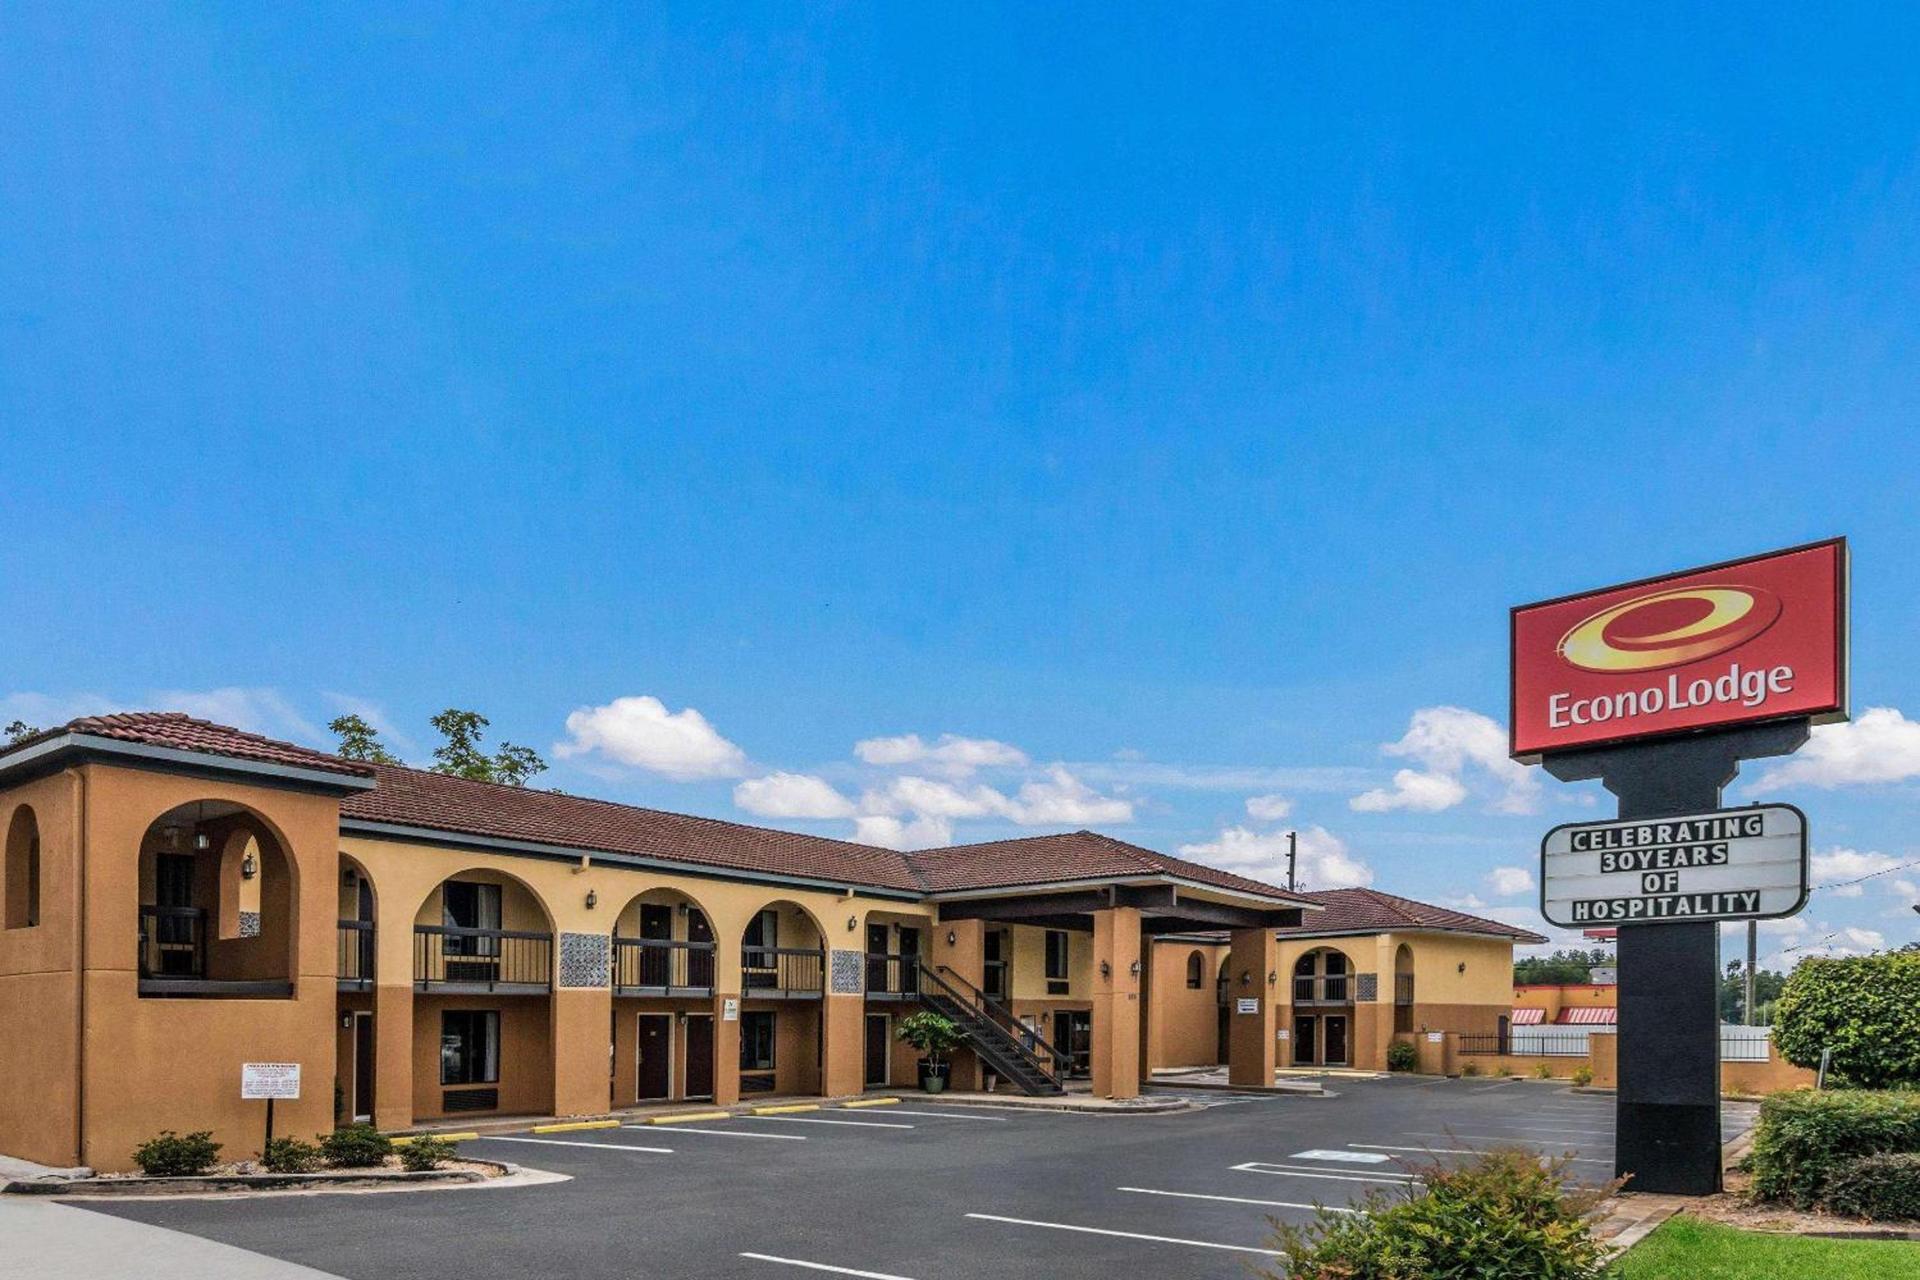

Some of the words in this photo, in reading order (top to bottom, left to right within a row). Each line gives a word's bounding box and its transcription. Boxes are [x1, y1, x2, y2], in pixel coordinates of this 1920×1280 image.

[1549, 663, 1793, 728] EconoLodge
[1573, 816, 1762, 851] CELEBRATING
[1602, 844, 1727, 872] 30YEARS
[1644, 872, 1678, 892] OF
[1575, 891, 1758, 920] HOSPITALITY
